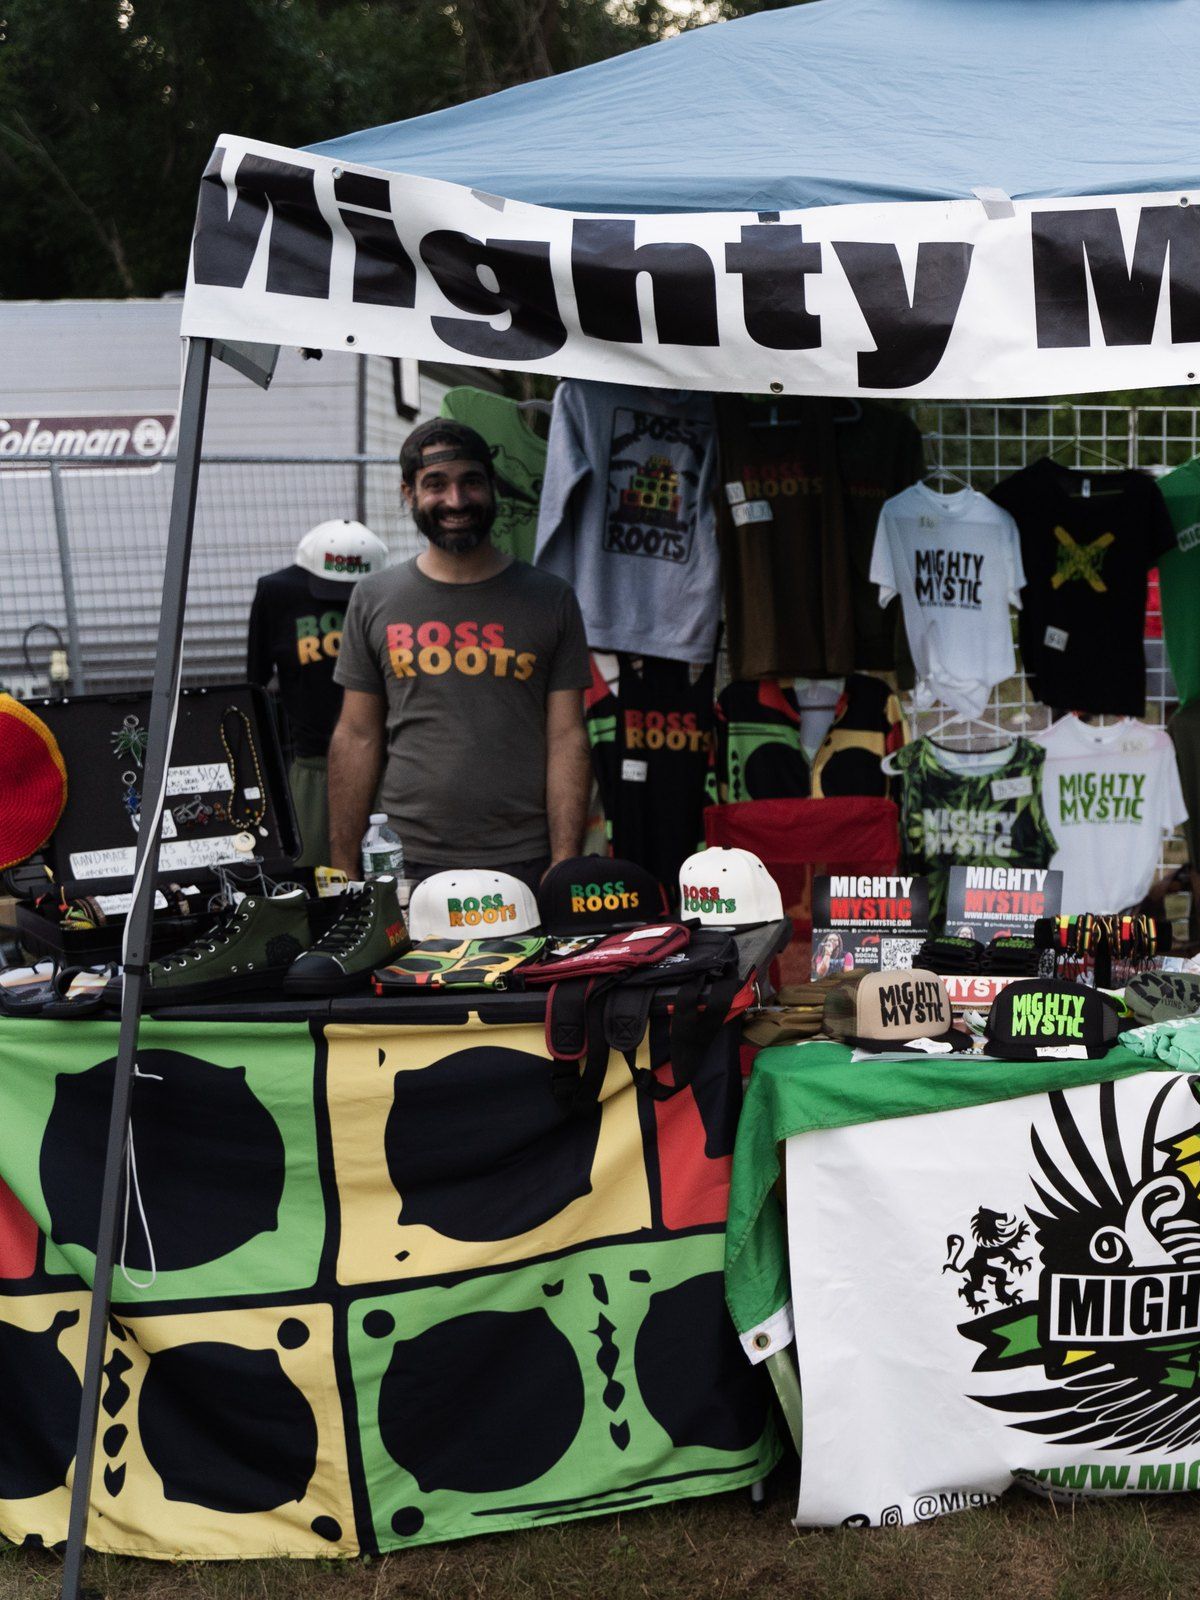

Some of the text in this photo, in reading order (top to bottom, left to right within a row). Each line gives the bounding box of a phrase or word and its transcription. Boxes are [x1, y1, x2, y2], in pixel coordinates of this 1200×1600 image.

[194, 146, 975, 389] Mighty
[607, 523, 686, 561] ROOTS
[324, 551, 363, 565] BOSS
[324, 561, 371, 574] ROOTS
[914, 549, 985, 576] MIGHTY
[914, 576, 984, 604] MYSTIC
[295, 610, 345, 640] BO
[386, 620, 505, 652] BOSS
[388, 646, 537, 681] ROOTS
[624, 709, 697, 732] BOSS
[625, 728, 716, 752] ROOTS
[1058, 771, 1146, 798] MIGHTY
[1059, 796, 1144, 820] MYSTIC
[922, 807, 1018, 837] MIGHTY
[923, 832, 1014, 858] MYSTIC
[569, 879, 626, 901] BOSS
[830, 876, 913, 899] MIGHTY
[965, 866, 1048, 891] MIGHTY
[447, 893, 505, 915] BOSS
[571, 891, 640, 914] ROOTS
[683, 884, 720, 901] BOSS
[683, 896, 737, 914] ROOTS
[964, 890, 1045, 915] MYSTIC
[448, 903, 517, 928] ROOTS
[830, 898, 912, 920] MYSTIC
[830, 919, 912, 927] WWW.MIGHTYMYSTIC.COM
[878, 981, 941, 1010] MIGHTY
[1012, 992, 1086, 1020] MIGHTY
[881, 1001, 946, 1028] MYSTIC
[1011, 1014, 1086, 1039] MYSTIC
